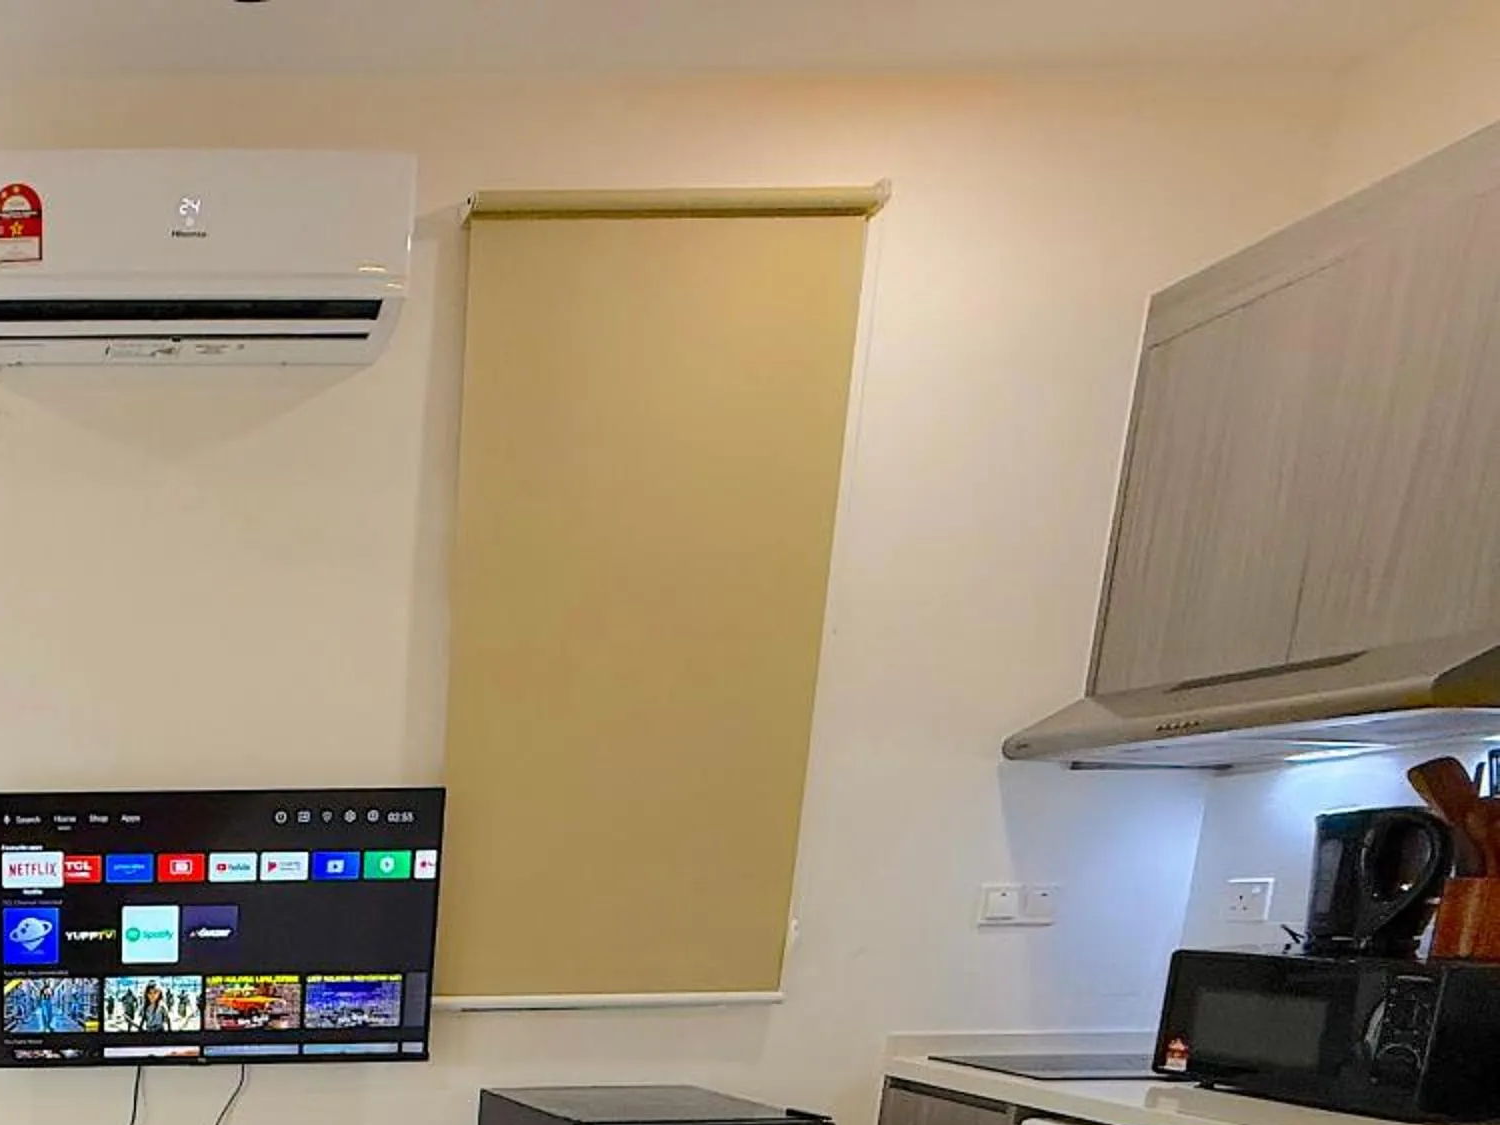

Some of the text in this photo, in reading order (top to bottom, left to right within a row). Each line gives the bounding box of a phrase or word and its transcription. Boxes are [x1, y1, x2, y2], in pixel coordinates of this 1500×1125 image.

[179, 198, 201, 215] 24
[15, 815, 41, 824] Search
[53, 815, 77, 823] Home
[89, 813, 109, 824] Shop
[121, 814, 141, 824] Apps
[8, 862, 58, 877] NETFLIX
[65, 861, 92, 871] TCL
[142, 929, 174, 940] Spotify
